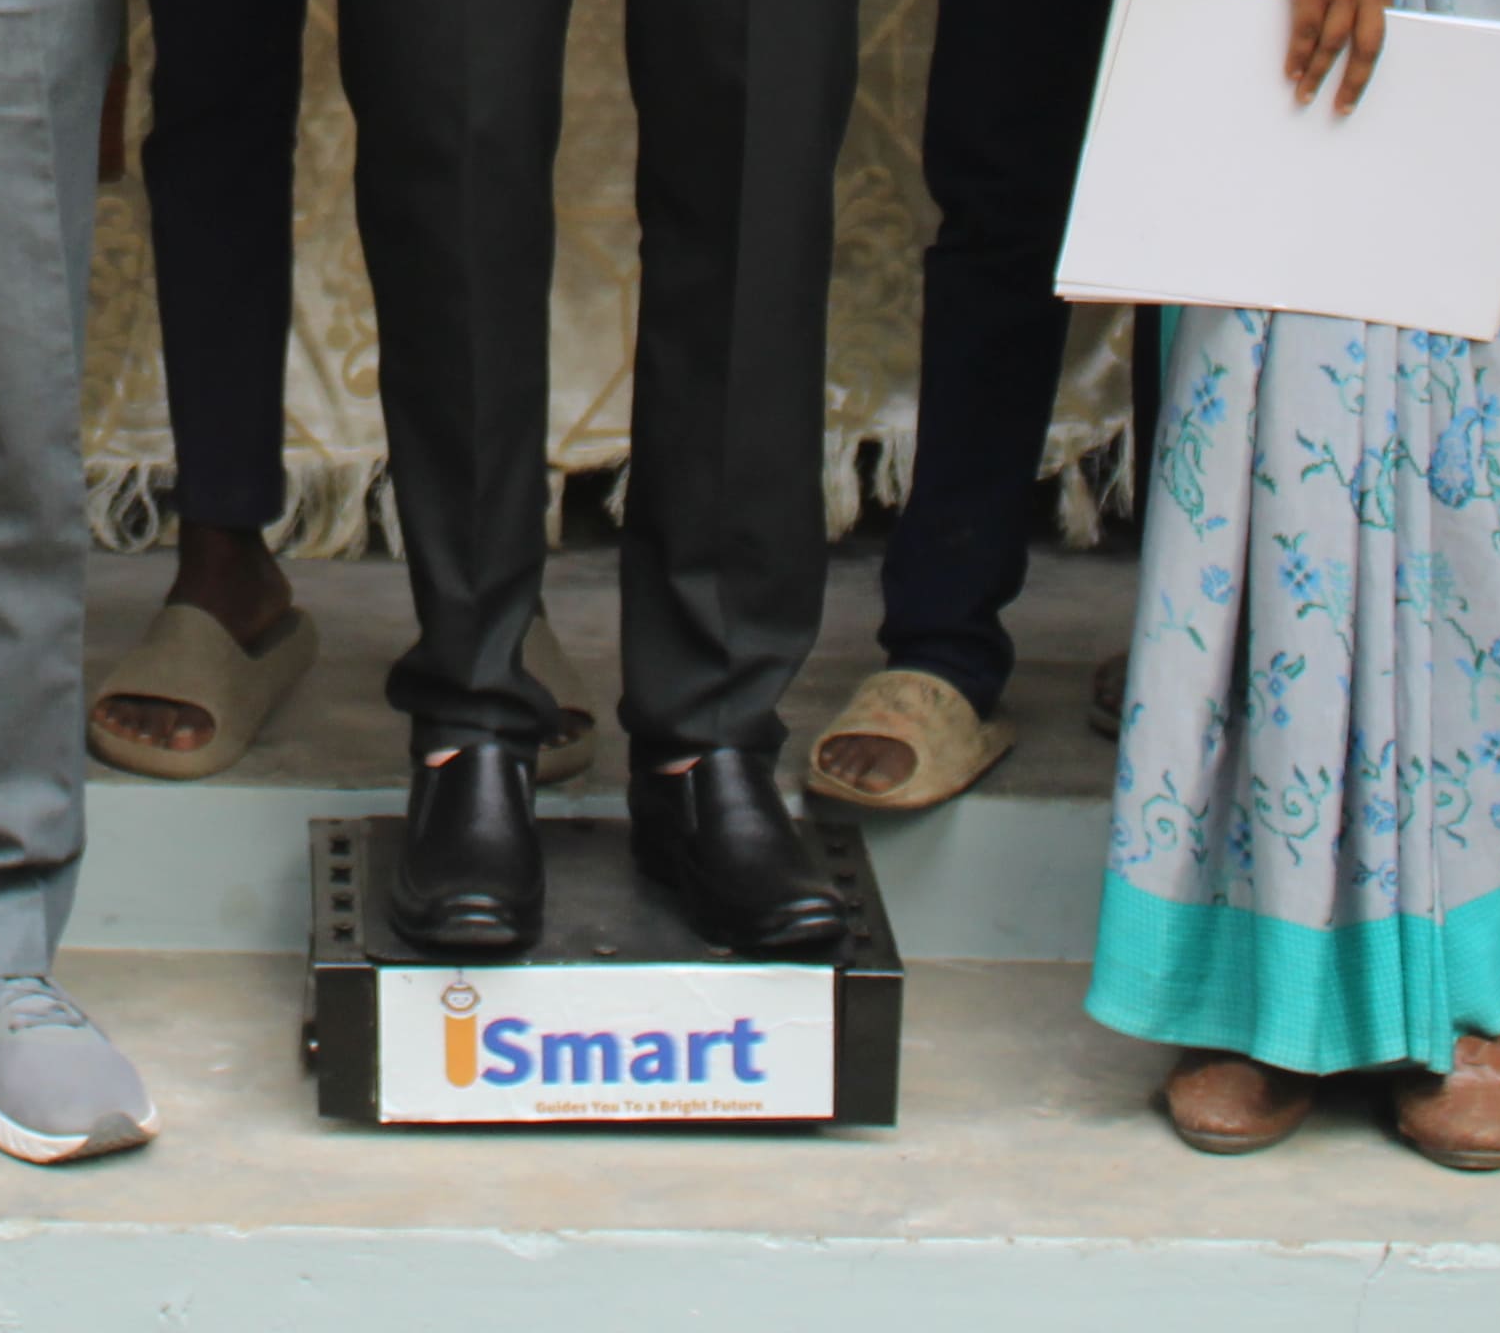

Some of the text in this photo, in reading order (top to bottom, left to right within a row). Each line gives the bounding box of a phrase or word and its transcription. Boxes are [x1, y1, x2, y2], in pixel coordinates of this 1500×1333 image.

[441, 969, 766, 1089] iSmart
[535, 1100, 587, 1113] Guides
[591, 1100, 619, 1112] You
[623, 1100, 642, 1112] To
[660, 1098, 707, 1115] Bright
[712, 1099, 763, 1112] Future
